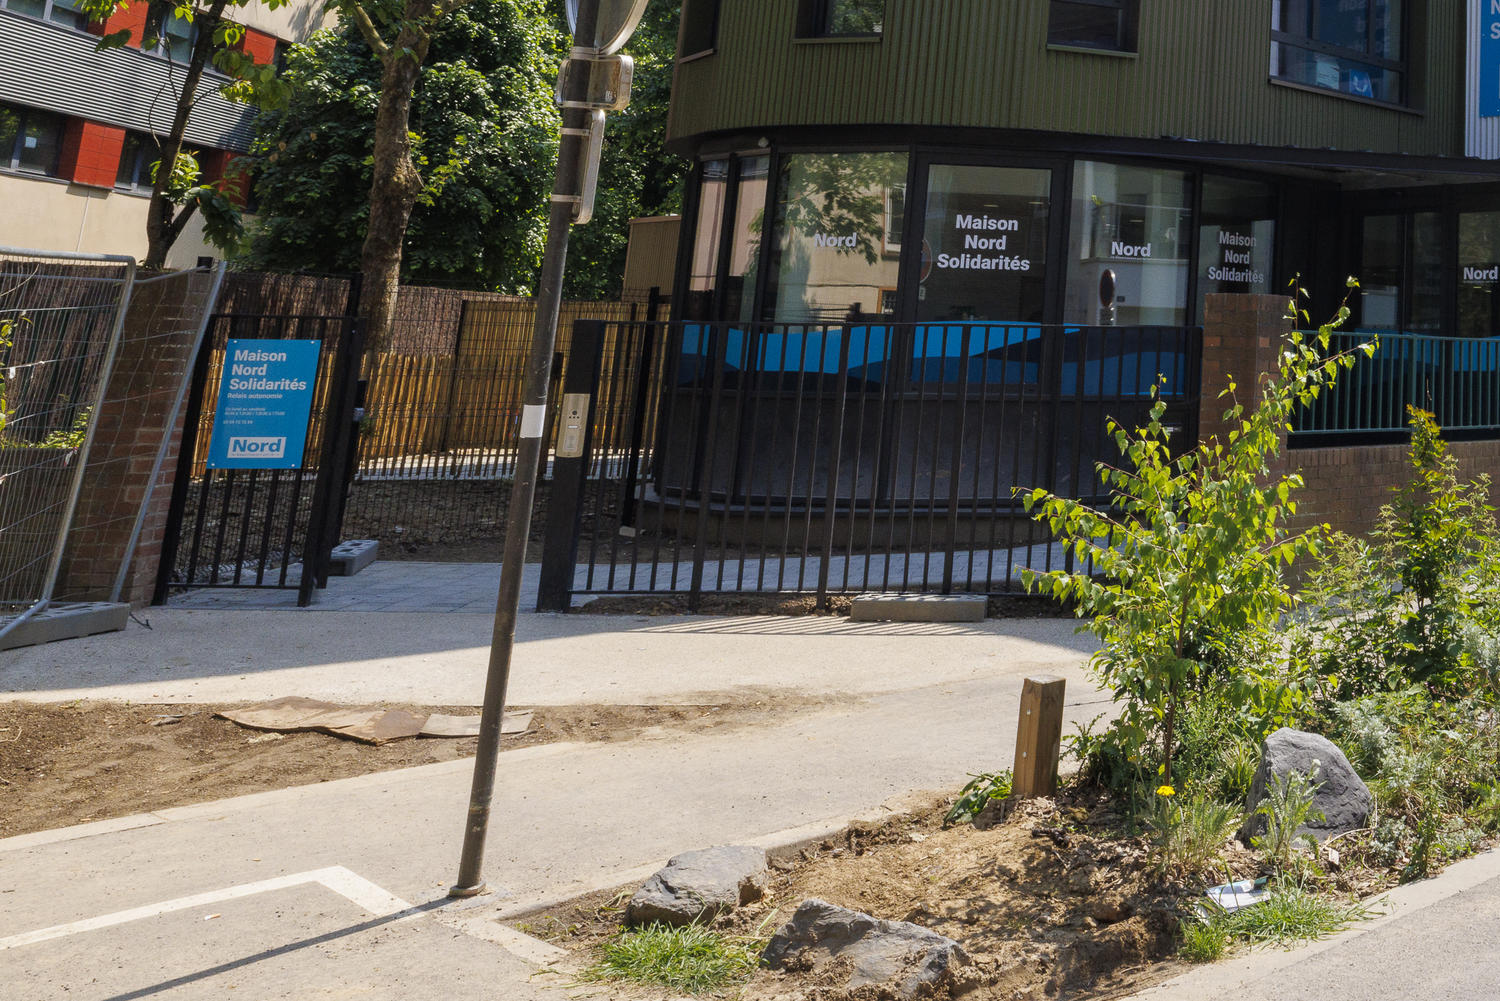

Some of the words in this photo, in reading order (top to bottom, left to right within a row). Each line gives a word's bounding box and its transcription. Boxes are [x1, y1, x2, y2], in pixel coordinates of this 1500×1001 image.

[955, 214, 1018, 231] Maison
[814, 232, 857, 247] Nord
[964, 234, 1007, 250] Nord
[1219, 231, 1256, 247] Maison
[1111, 241, 1152, 257] Nord
[937, 253, 1030, 271] Solidarités
[1225, 250, 1250, 264] Nord
[1208, 266, 1264, 283] Solidarités
[1463, 266, 1498, 280] Nord
[234, 350, 287, 362] Maison
[232, 364, 267, 376] Nord
[229, 378, 307, 390] Solidarités
[232, 439, 282, 453] Nord
